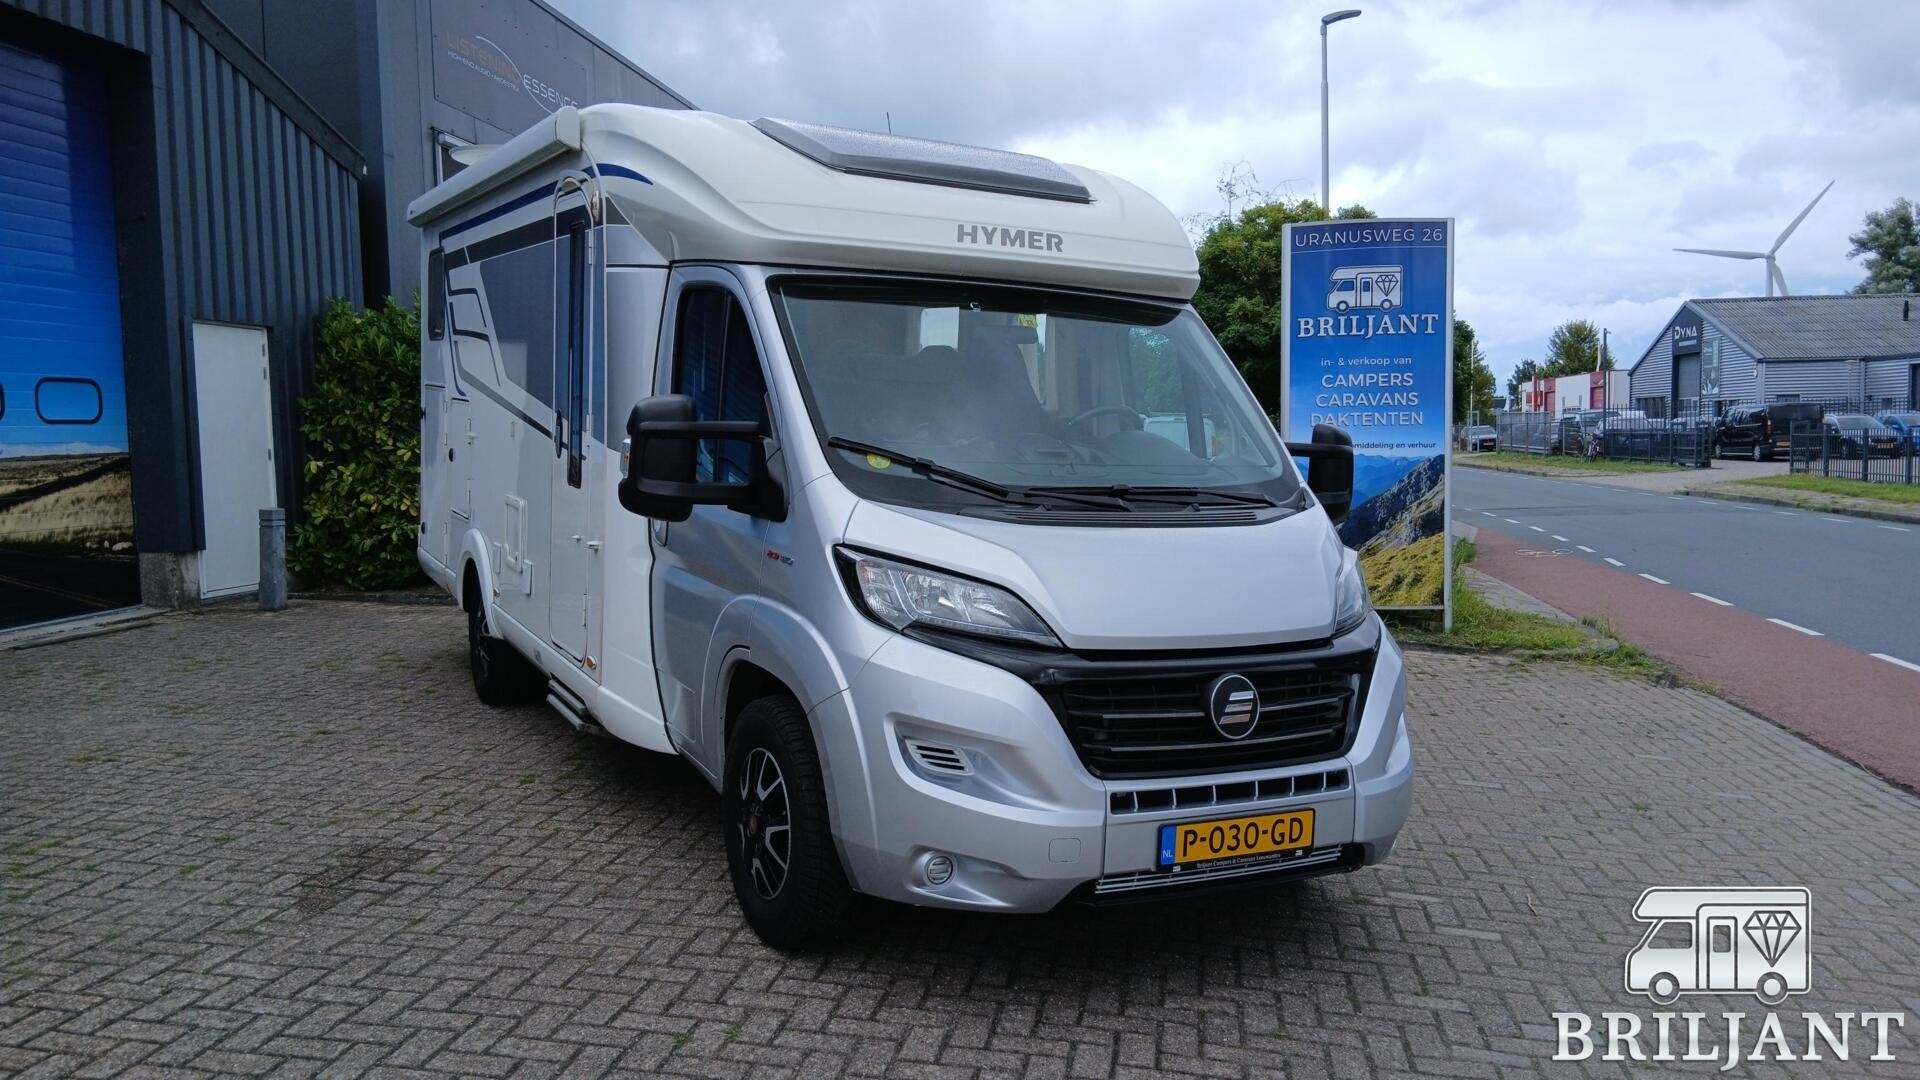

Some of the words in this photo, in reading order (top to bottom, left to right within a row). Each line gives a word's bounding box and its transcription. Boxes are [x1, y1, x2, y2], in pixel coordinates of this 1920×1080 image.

[957, 223, 1064, 253] HYMER
[1295, 229, 1415, 247] URANUSWEG
[1422, 228, 1443, 242] 26
[1297, 313, 1439, 339] BRILJANT
[1674, 326, 1697, 339] DYNA
[1321, 357, 1335, 366] in-
[1338, 357, 1345, 366] &
[1347, 357, 1390, 368] verkoop
[1393, 357, 1412, 366] van
[1321, 372, 1413, 388] CAMPERS
[1315, 391, 1419, 407] CARAVANS
[1310, 411, 1424, 427] DAKTENTEN
[1182, 817, 1304, 857] P-030-GD
[1162, 850, 1173, 858] NL
